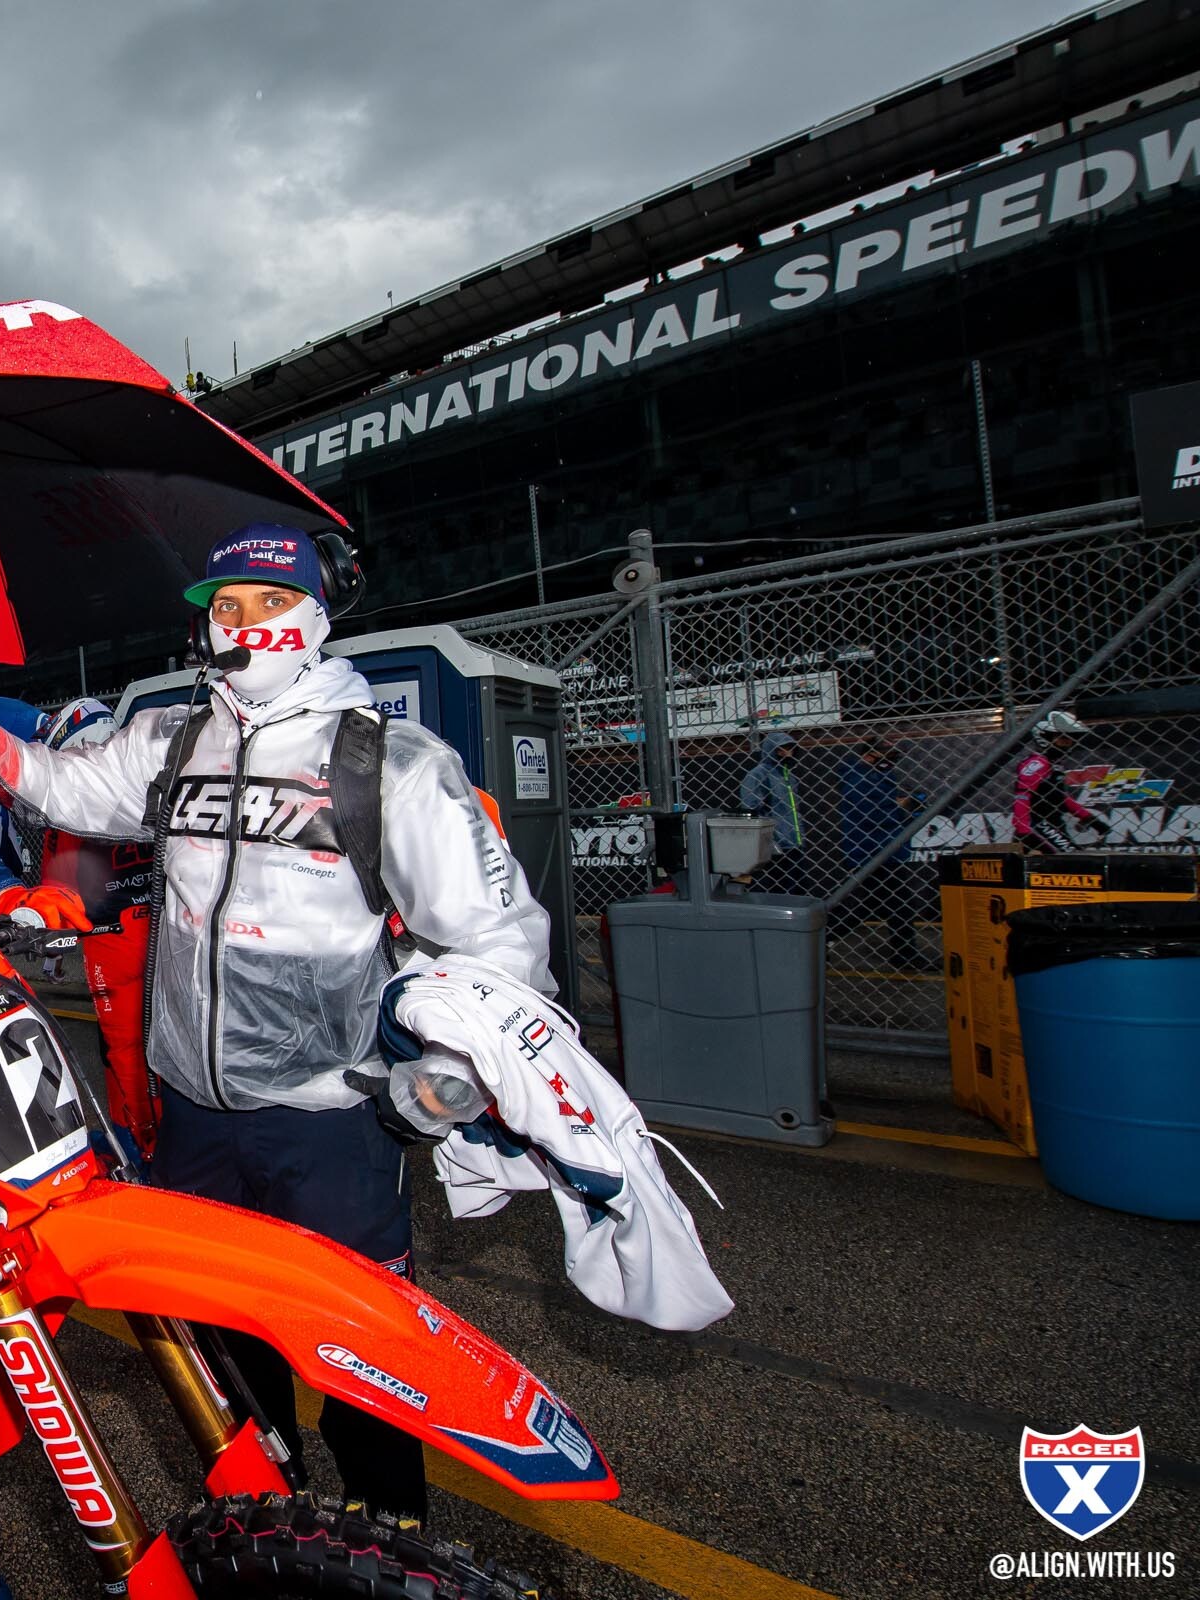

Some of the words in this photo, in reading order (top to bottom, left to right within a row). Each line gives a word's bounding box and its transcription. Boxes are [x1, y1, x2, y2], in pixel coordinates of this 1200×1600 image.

[782, 651, 828, 668] LANE
[520, 750, 545, 767] United
[168, 782, 333, 842] LEATT
[291, 862, 337, 880] Concepts
[61, 1160, 89, 1181] HONDA
